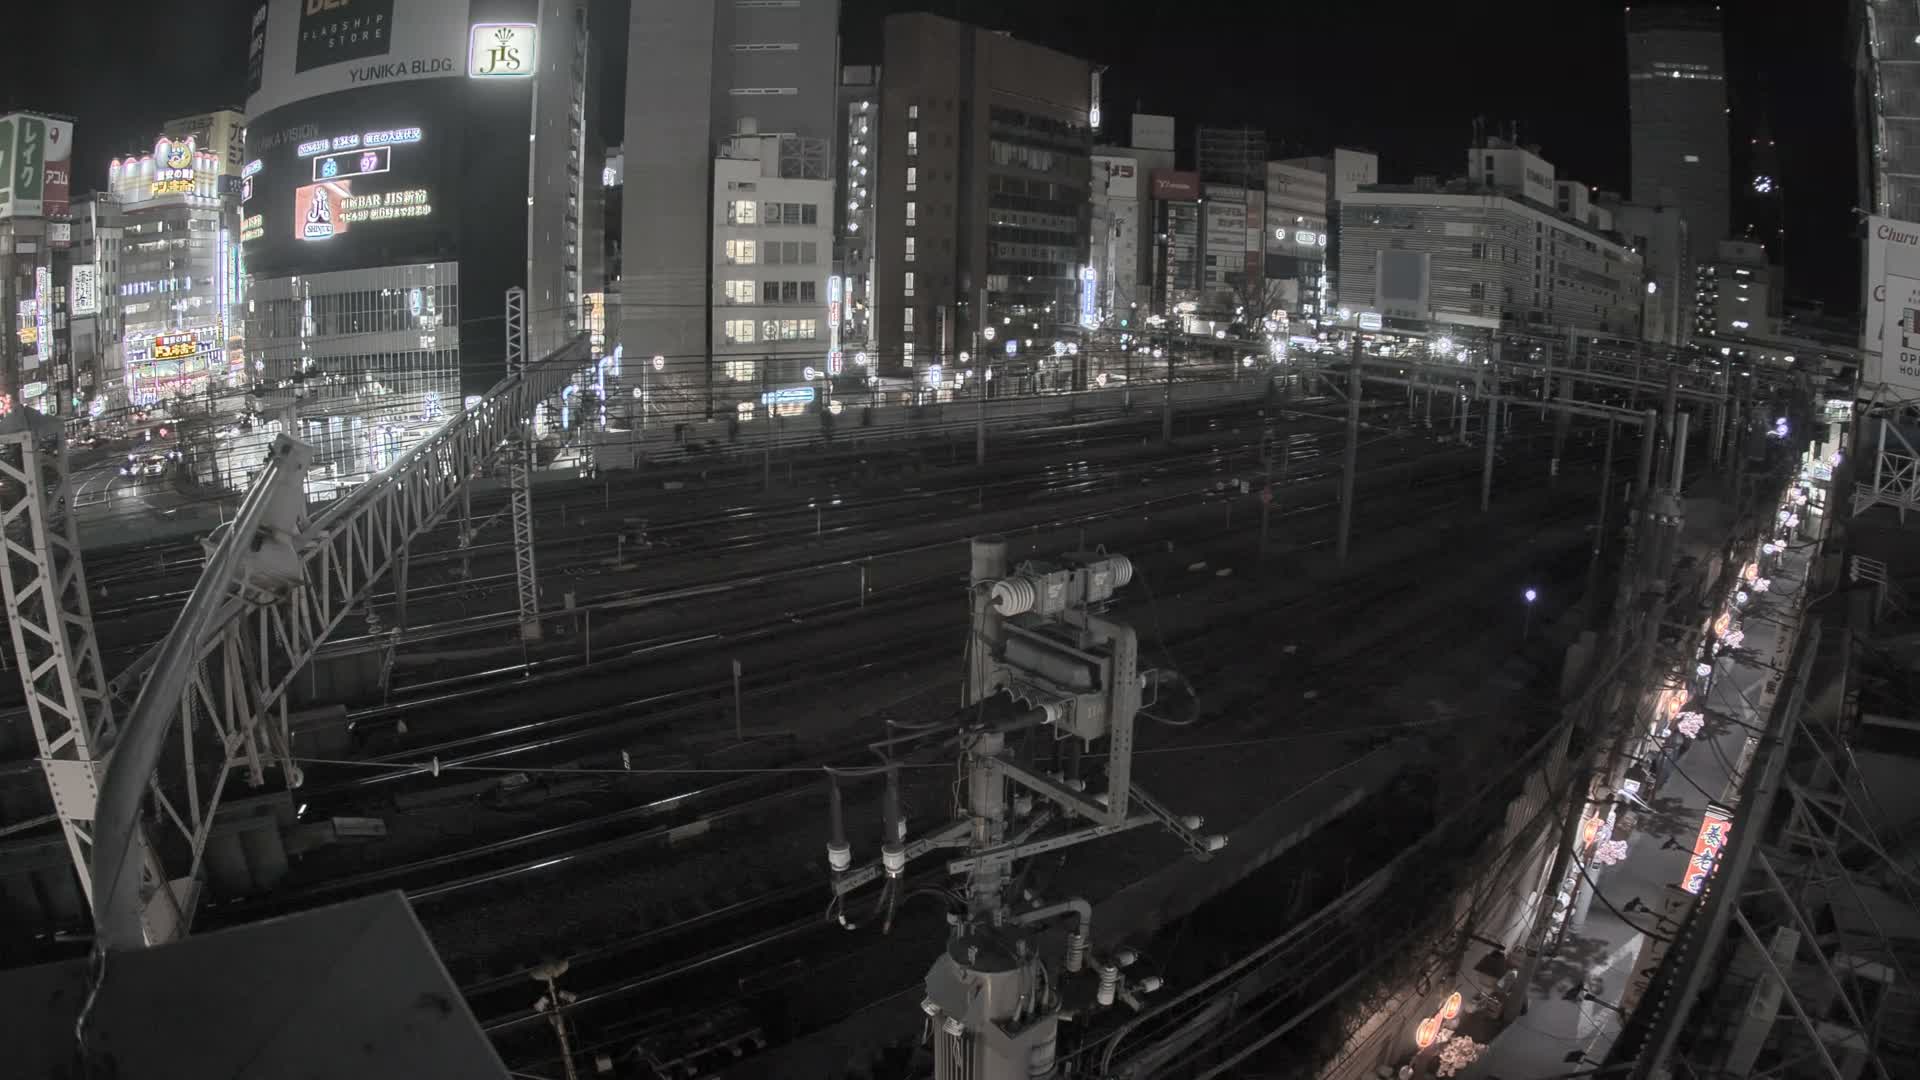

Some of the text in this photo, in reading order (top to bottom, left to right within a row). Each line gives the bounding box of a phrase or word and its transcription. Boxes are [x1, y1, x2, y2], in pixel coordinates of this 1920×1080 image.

[303, 14, 384, 41] FLAGSHIP
[328, 28, 383, 49] STORE
[349, 58, 456, 83] YUNIKA BLDG.
[20, 121, 37, 188] レイク
[360, 157, 378, 172] 97
[45, 170, 69, 185] アコム
[1877, 224, 1919, 246] Churu
